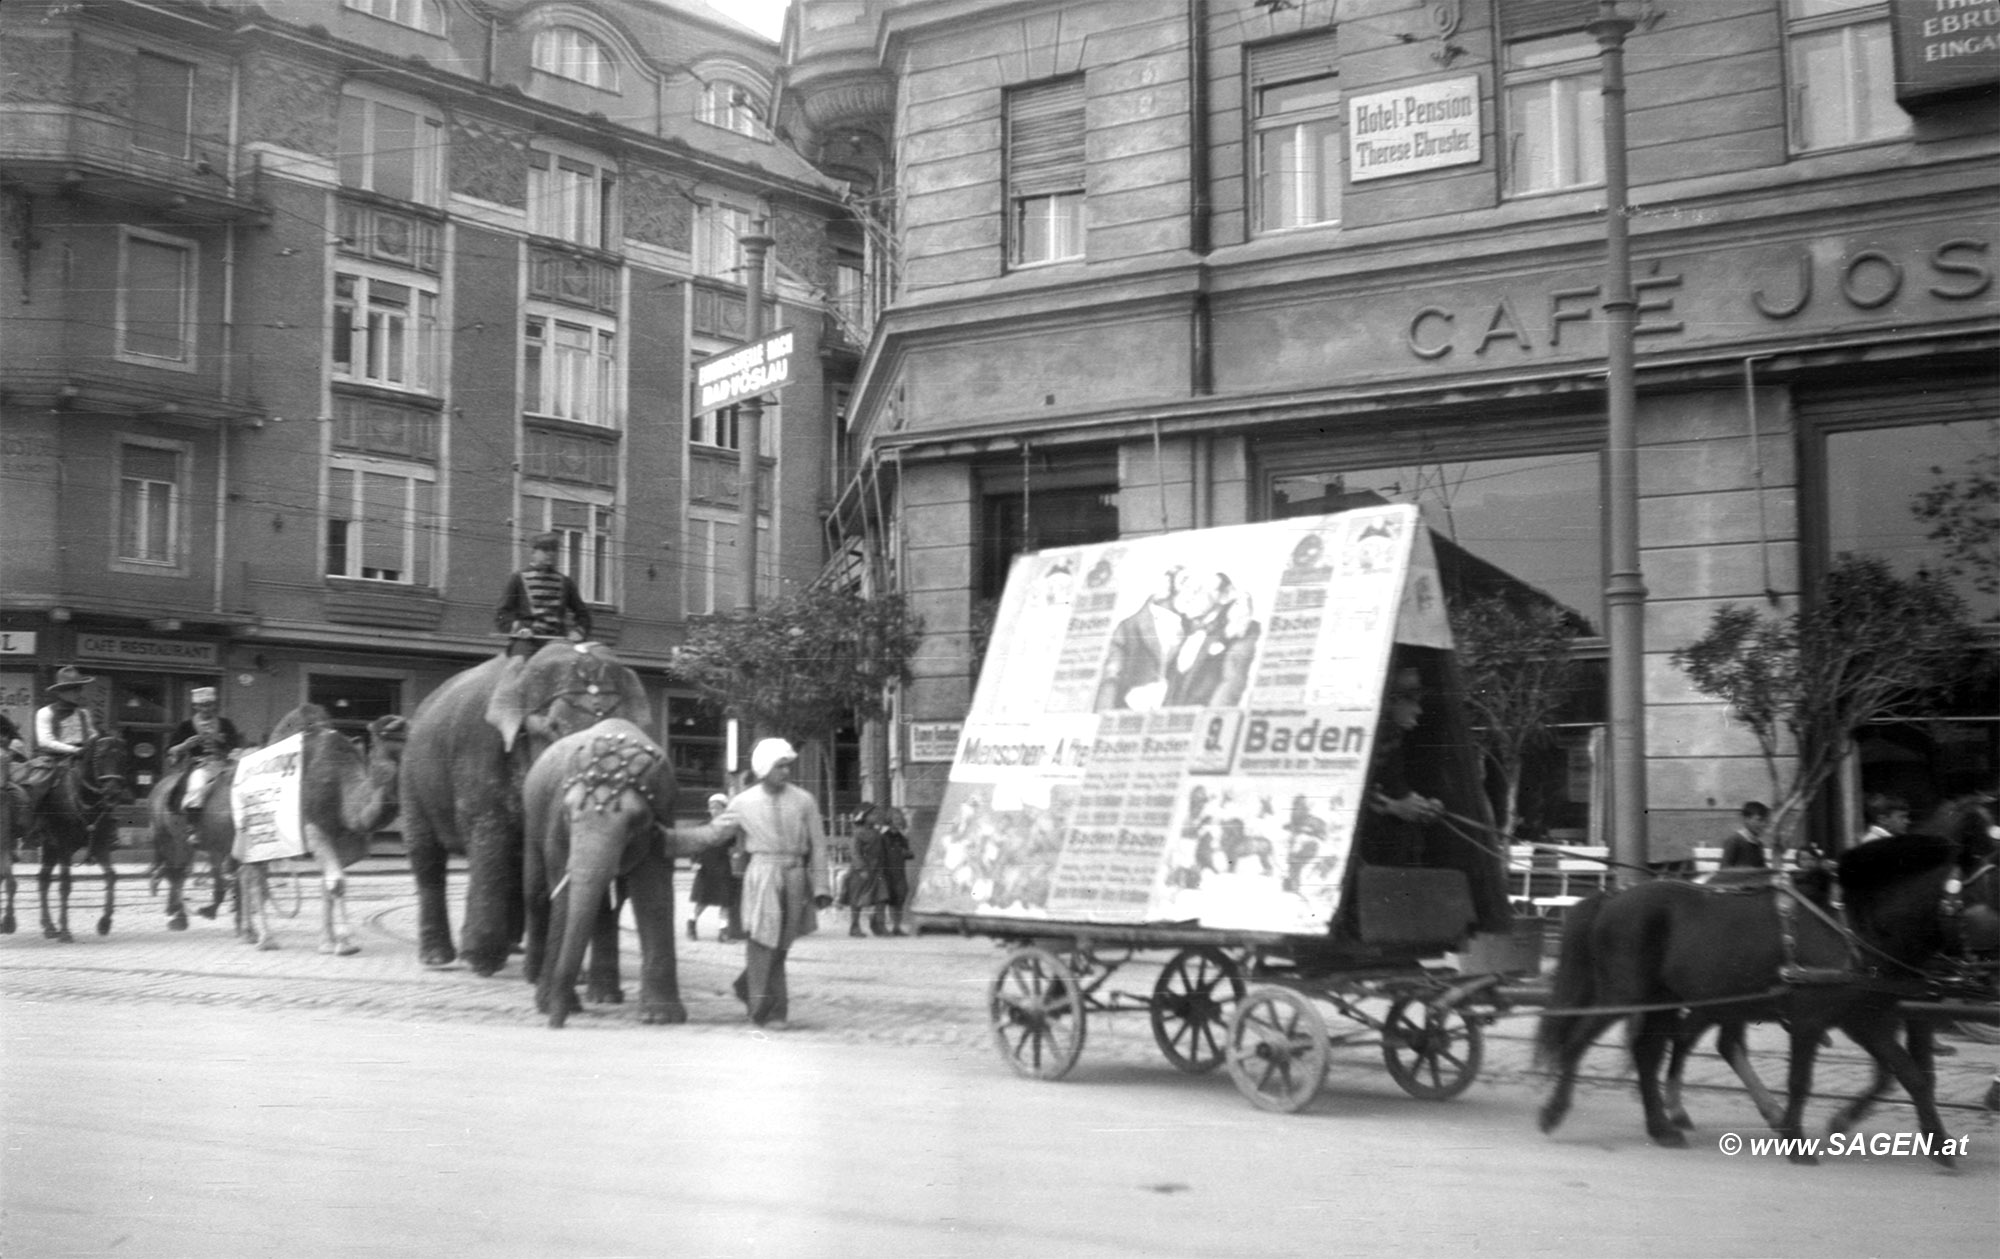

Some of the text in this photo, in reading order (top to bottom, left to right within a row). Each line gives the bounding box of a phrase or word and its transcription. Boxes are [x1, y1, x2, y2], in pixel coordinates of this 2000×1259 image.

[1925, 33, 2000, 62] EINGA
[1409, 239, 1994, 359] CAFÉ JOS
[1244, 719, 1365, 753] Baden
